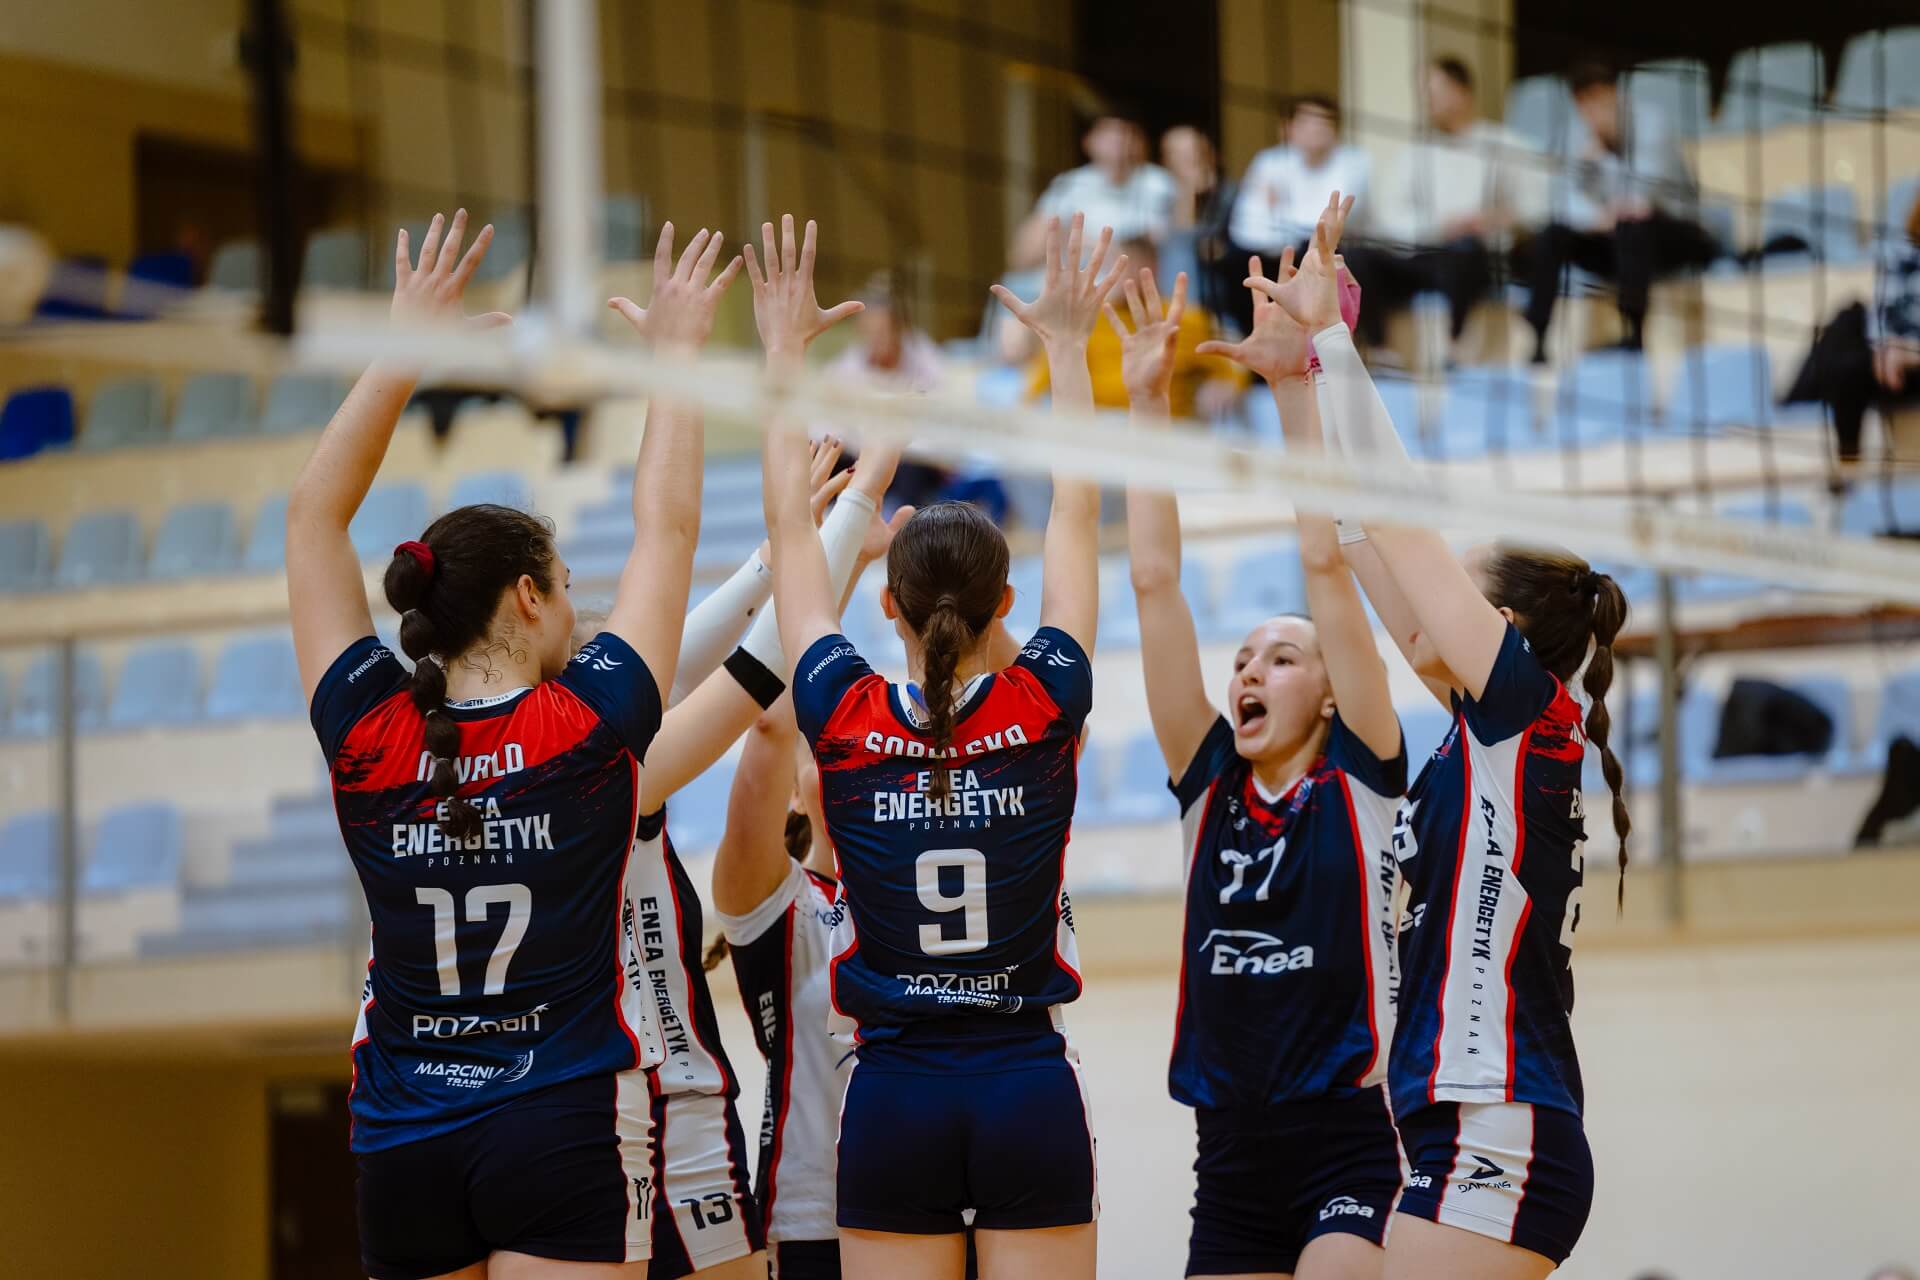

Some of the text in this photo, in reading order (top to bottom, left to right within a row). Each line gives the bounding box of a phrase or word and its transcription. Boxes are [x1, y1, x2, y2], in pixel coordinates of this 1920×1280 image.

[917, 769, 981, 792] EEA
[414, 883, 533, 996] 17
[639, 896, 664, 963] ENEA
[914, 848, 989, 957] 9
[1471, 864, 1504, 961] ENERGETYK
[1210, 944, 1314, 976] Enea
[648, 969, 690, 1056] ENERGETYK
[680, 1191, 735, 1230] 13
